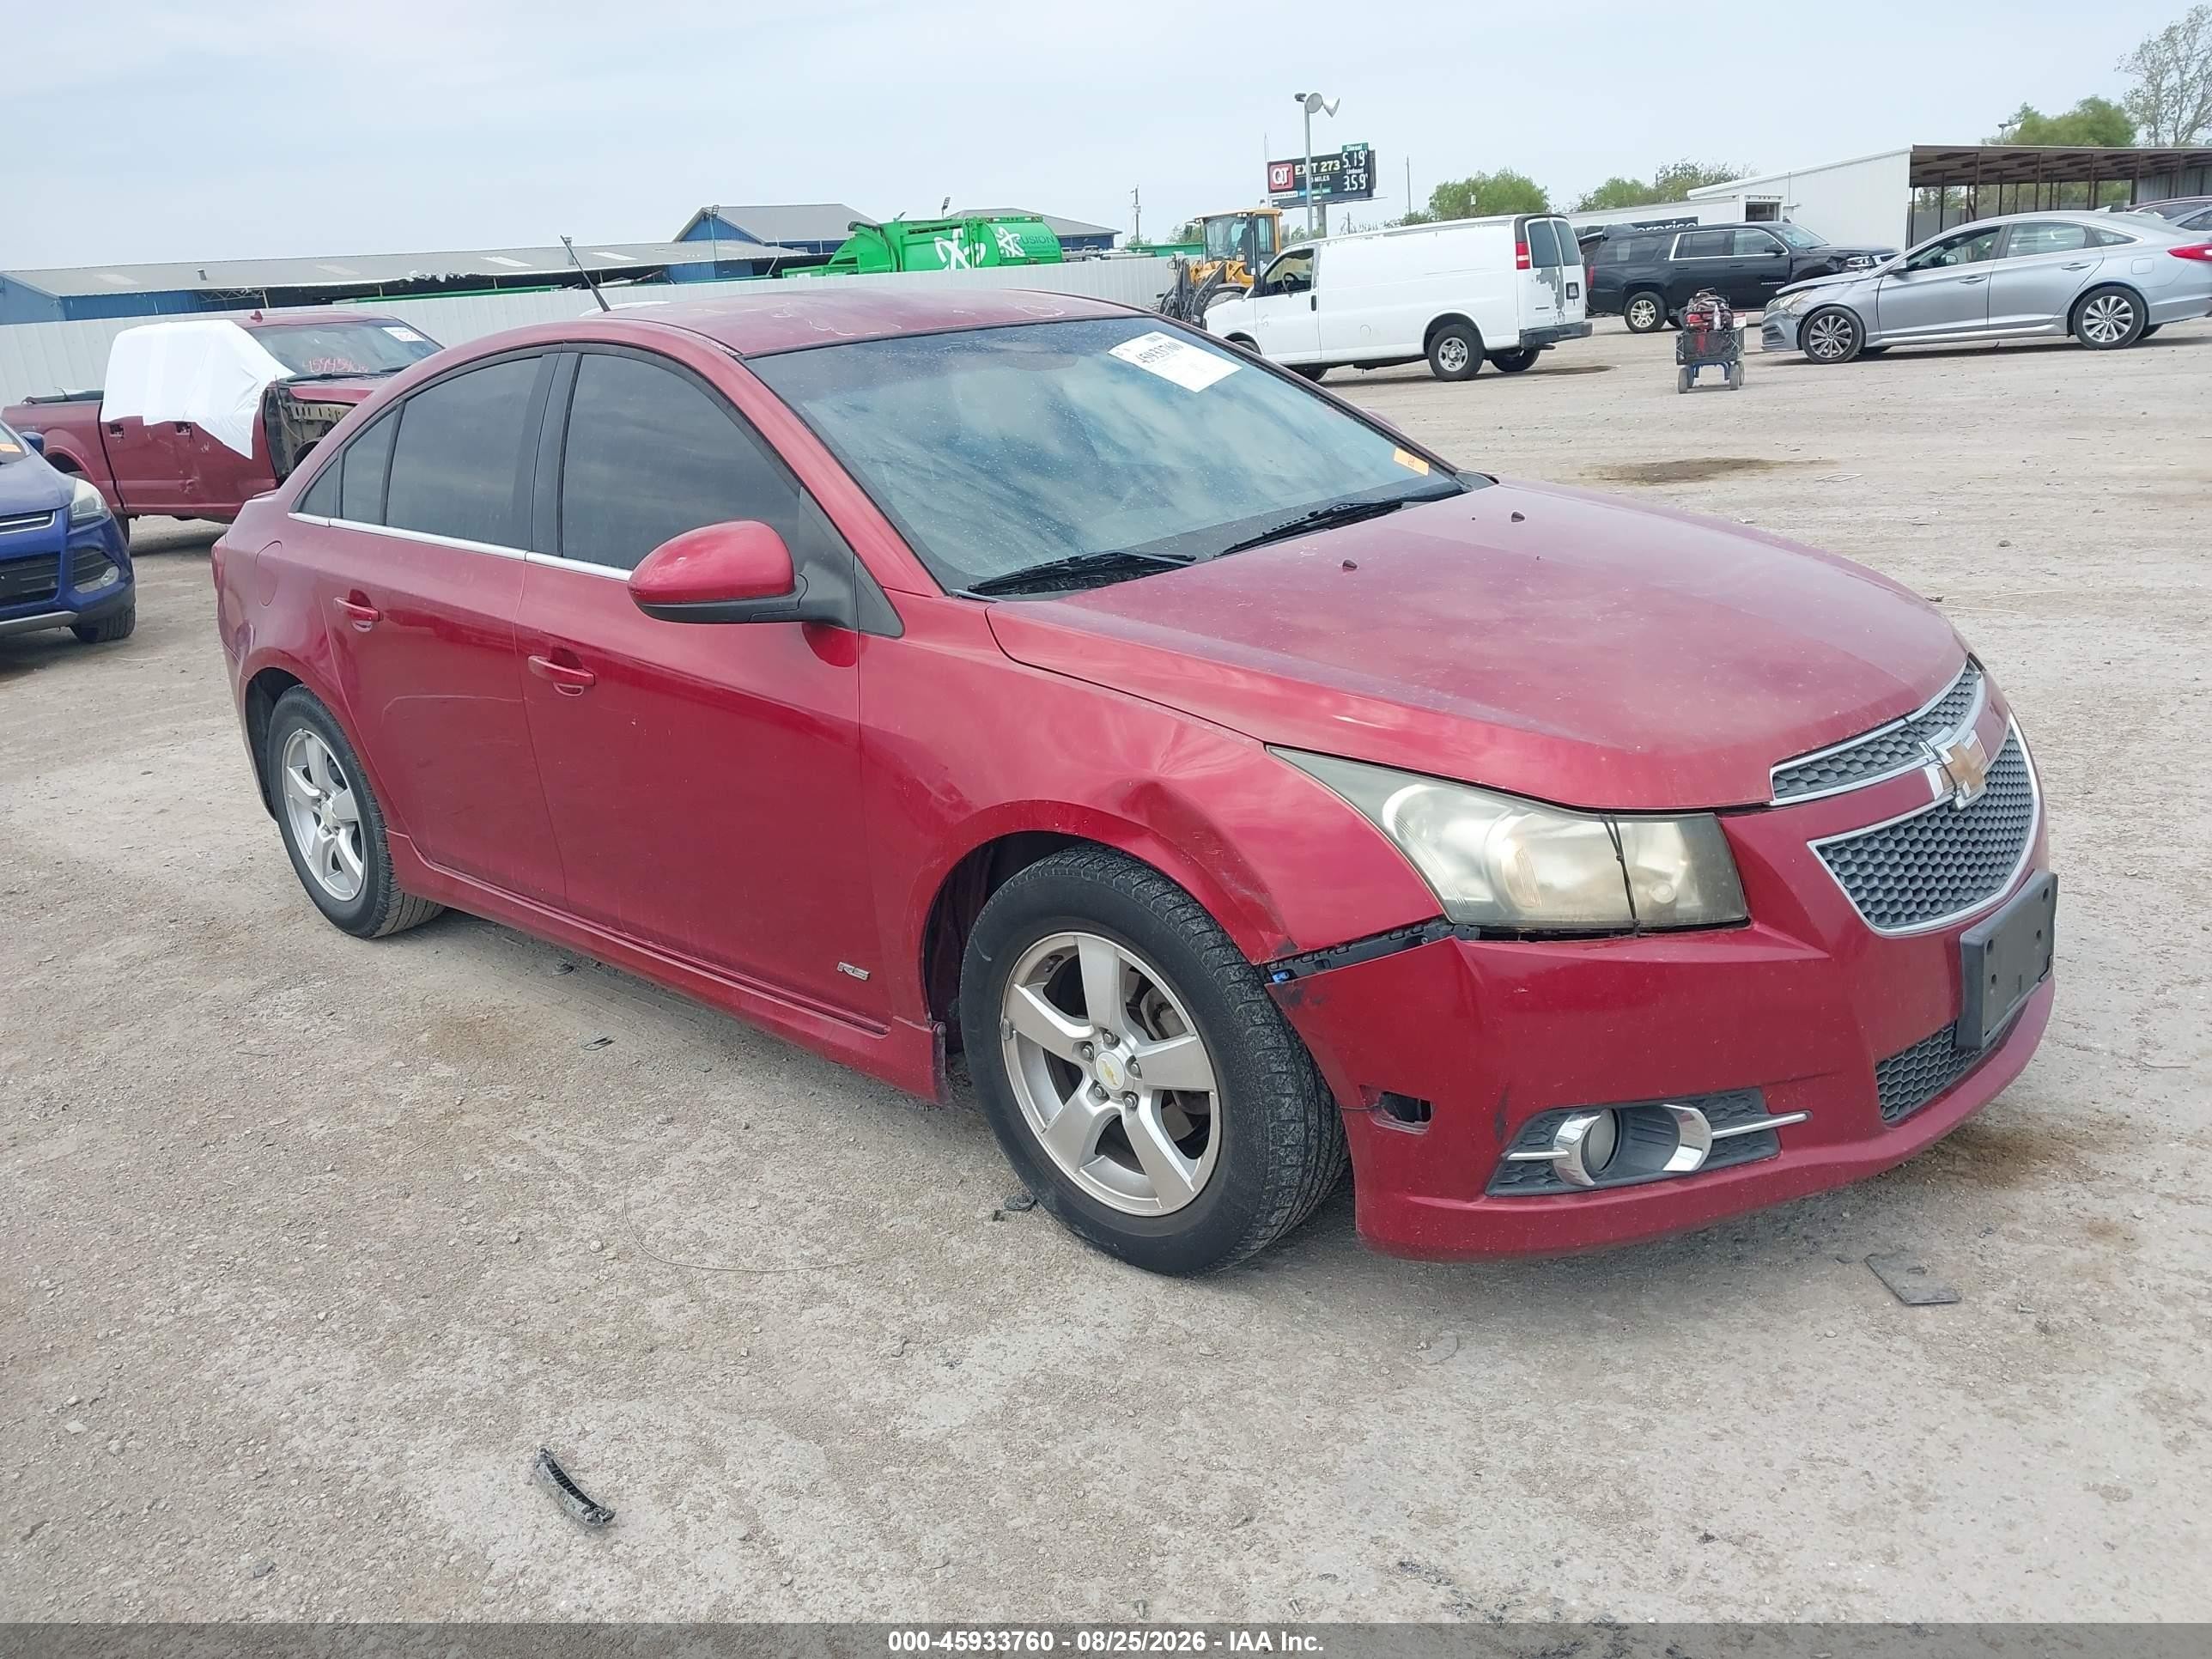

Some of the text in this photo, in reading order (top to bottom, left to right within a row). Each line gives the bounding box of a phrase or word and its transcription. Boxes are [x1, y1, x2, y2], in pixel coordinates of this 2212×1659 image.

[1295, 160, 1340, 175] EXT 273
[1272, 167, 1291, 185] QT
